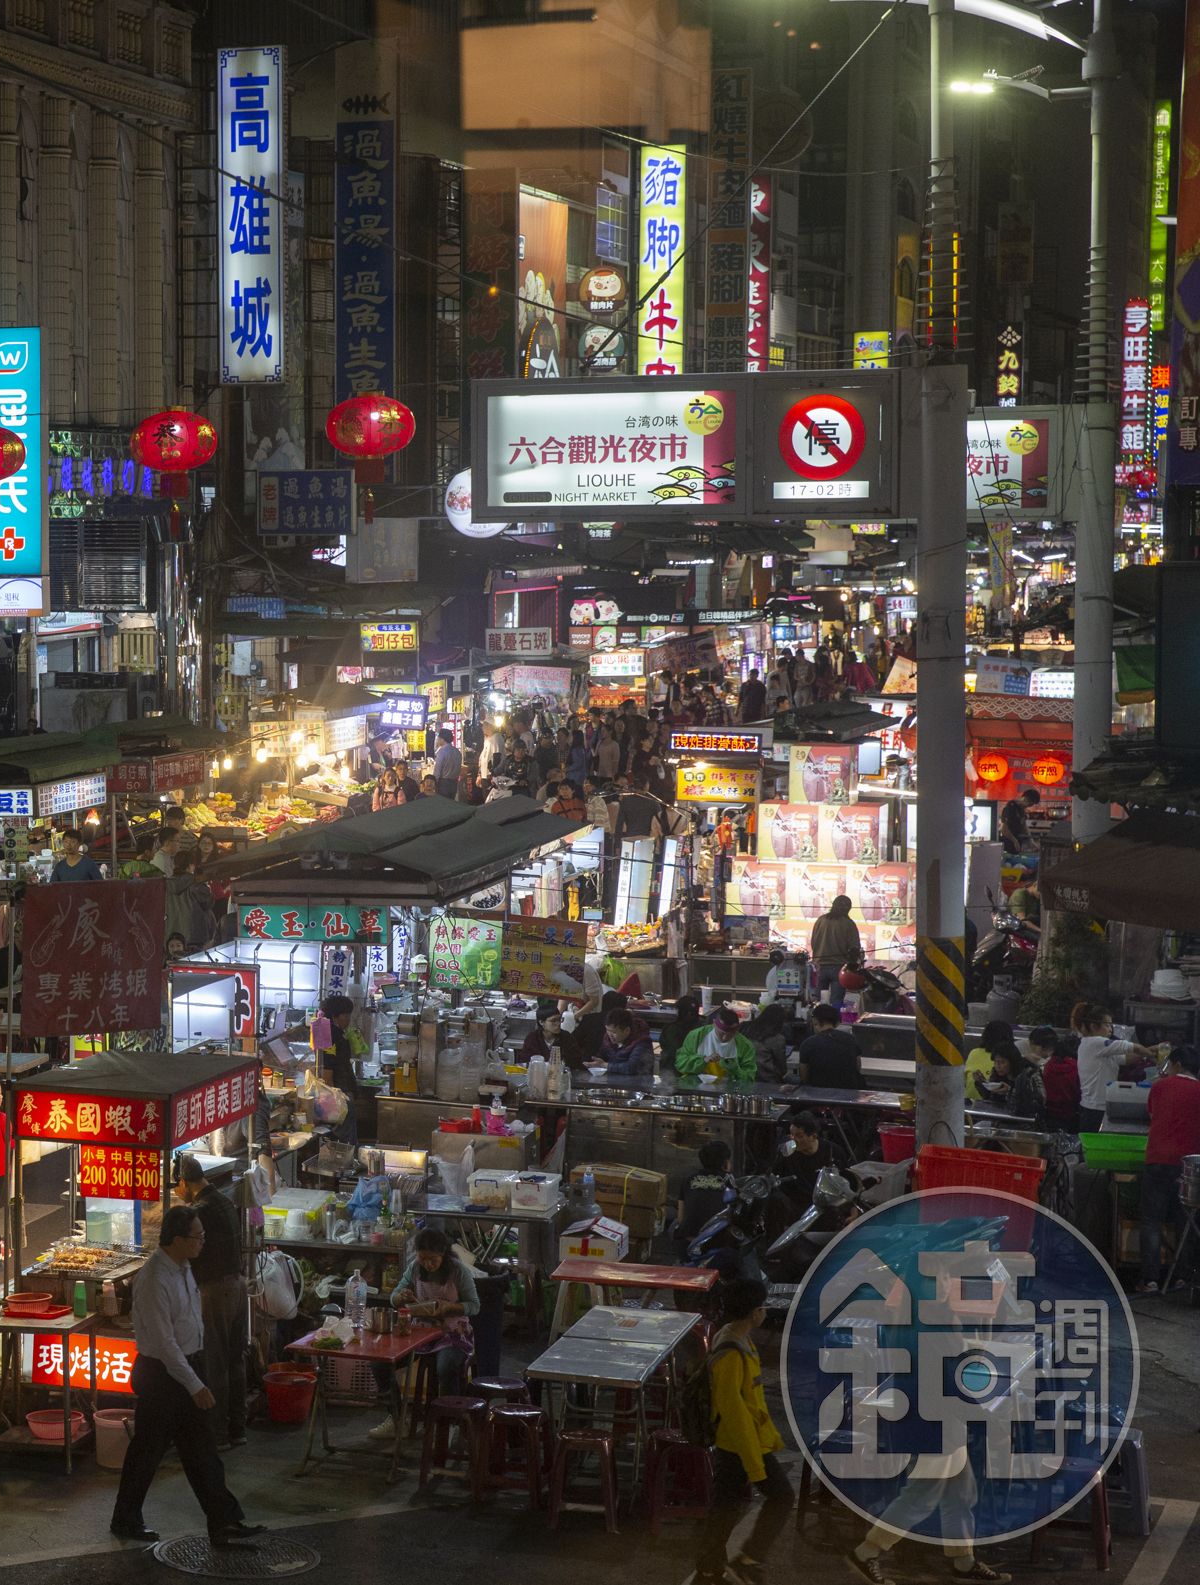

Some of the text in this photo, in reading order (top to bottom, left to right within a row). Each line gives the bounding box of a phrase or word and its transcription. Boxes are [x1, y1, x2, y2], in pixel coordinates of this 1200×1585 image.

[1154, 182, 1164, 208] Hotel
[230, 73, 273, 364] 高雄城
[0, 350, 21, 366] W
[1122, 305, 1150, 451] 亨旺養生館
[624, 414, 679, 428] 台湾の味
[805, 420, 841, 456] 停
[509, 433, 688, 465] 六合觀光夜市
[283, 477, 348, 500] 過魚湯
[577, 474, 635, 487] LIOUHE
[554, 492, 589, 503] NIGHT
[592, 491, 637, 502] MARKET
[67, 897, 111, 956] 廖
[372, 963, 385, 973] 20
[436, 959, 459, 971] QQ
[36, 968, 147, 1004] 專業烤蝦
[57, 1003, 130, 1030] 十八年
[174, 1069, 257, 1138] 廖師傅泰國蝦
[43, 1098, 136, 1137] 泰國蝦
[83, 1149, 107, 1163] 小号
[111, 1151, 134, 1166] 中号
[135, 1153, 159, 1167] 大号
[82, 1166, 107, 1187] 200
[110, 1168, 133, 1189] 300
[134, 1169, 159, 1189] 500
